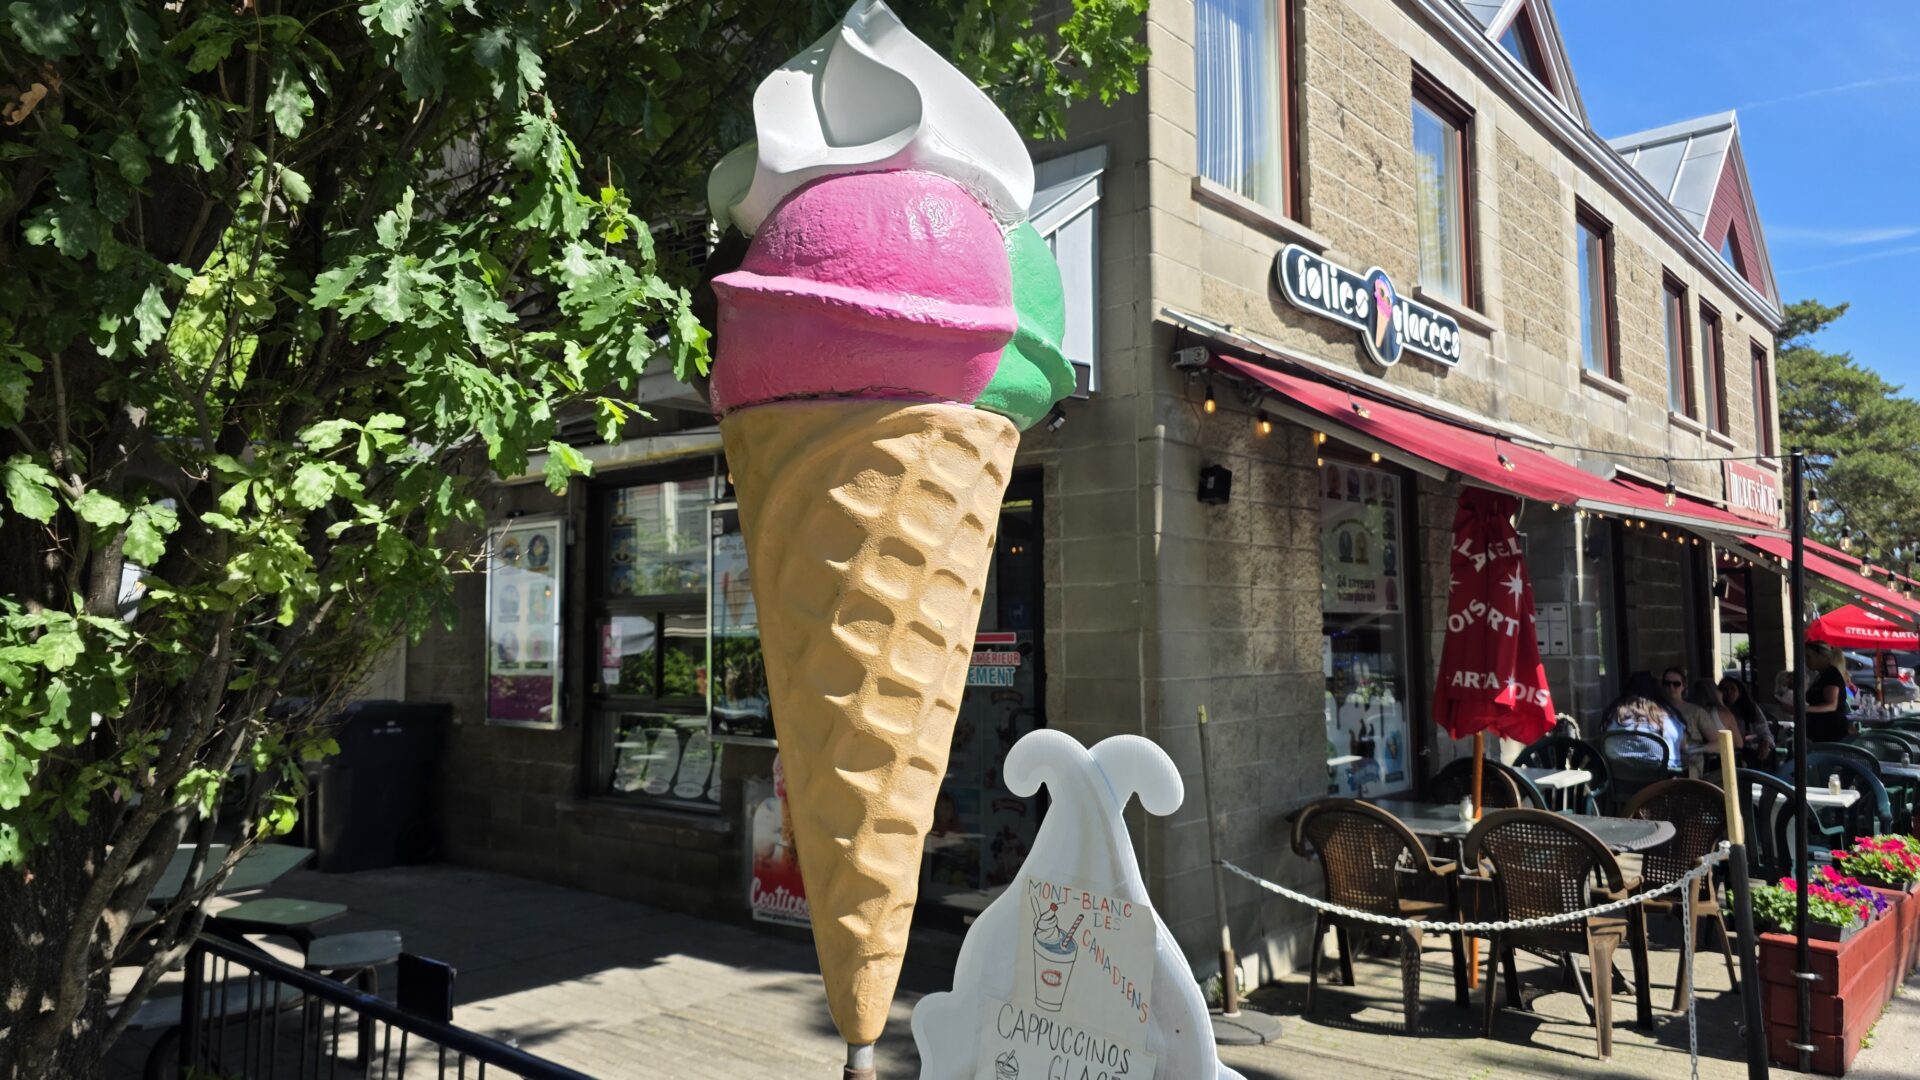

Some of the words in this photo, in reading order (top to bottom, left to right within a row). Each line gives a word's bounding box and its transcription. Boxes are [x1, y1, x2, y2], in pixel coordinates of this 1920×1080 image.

[1297, 254, 1369, 319] folies
[1845, 627, 1880, 637] STELLA
[1028, 879, 1132, 918] MONT-BLANC
[1093, 912, 1121, 931] DES
[1082, 928, 1149, 1023] CANADIENS
[997, 1003, 1131, 1075] CAPPUCCINOS
